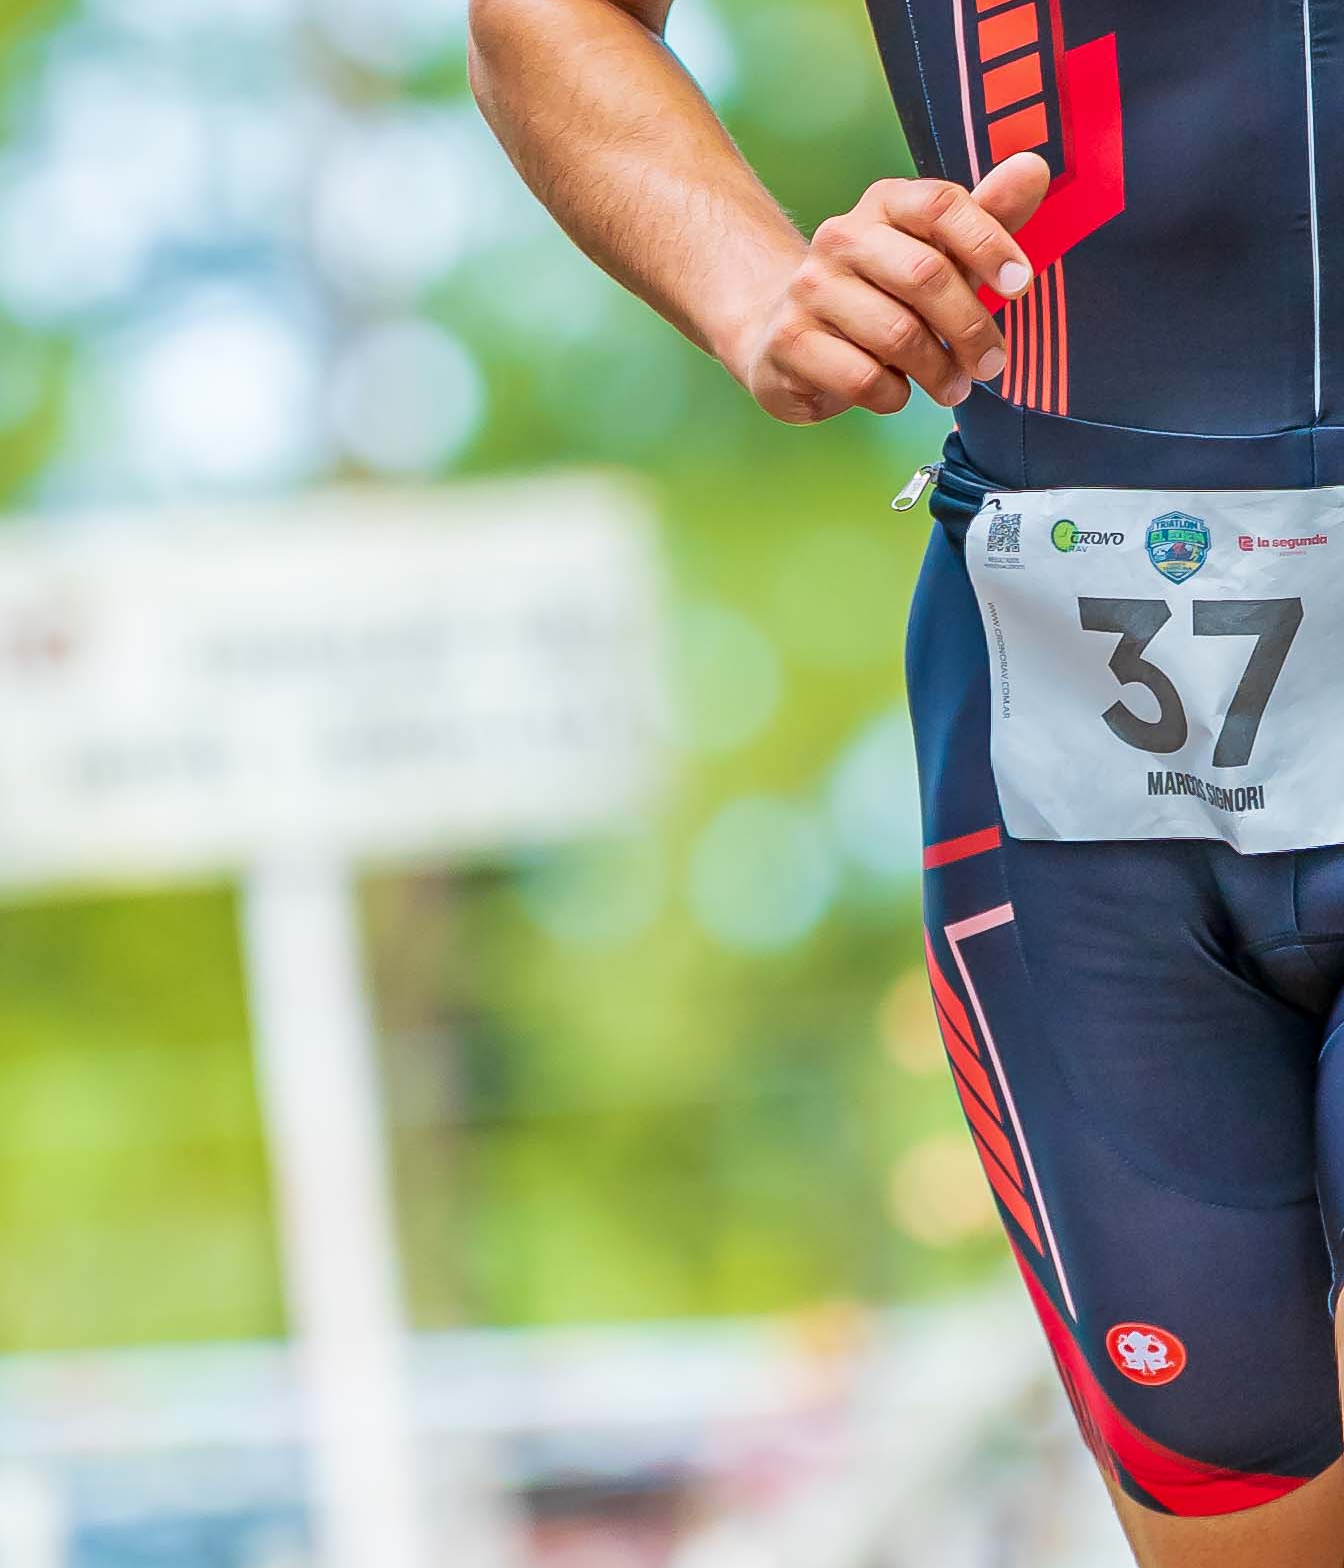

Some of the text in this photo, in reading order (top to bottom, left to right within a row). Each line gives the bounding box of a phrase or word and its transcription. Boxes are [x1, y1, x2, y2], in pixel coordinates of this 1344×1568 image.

[1156, 519, 1198, 530] TRIATLON
[1070, 531, 1125, 546] CRONO
[1257, 533, 1328, 550] la segunda
[1078, 597, 1304, 769] 37
[1147, 771, 1265, 812] MARCOS SIGNORI
